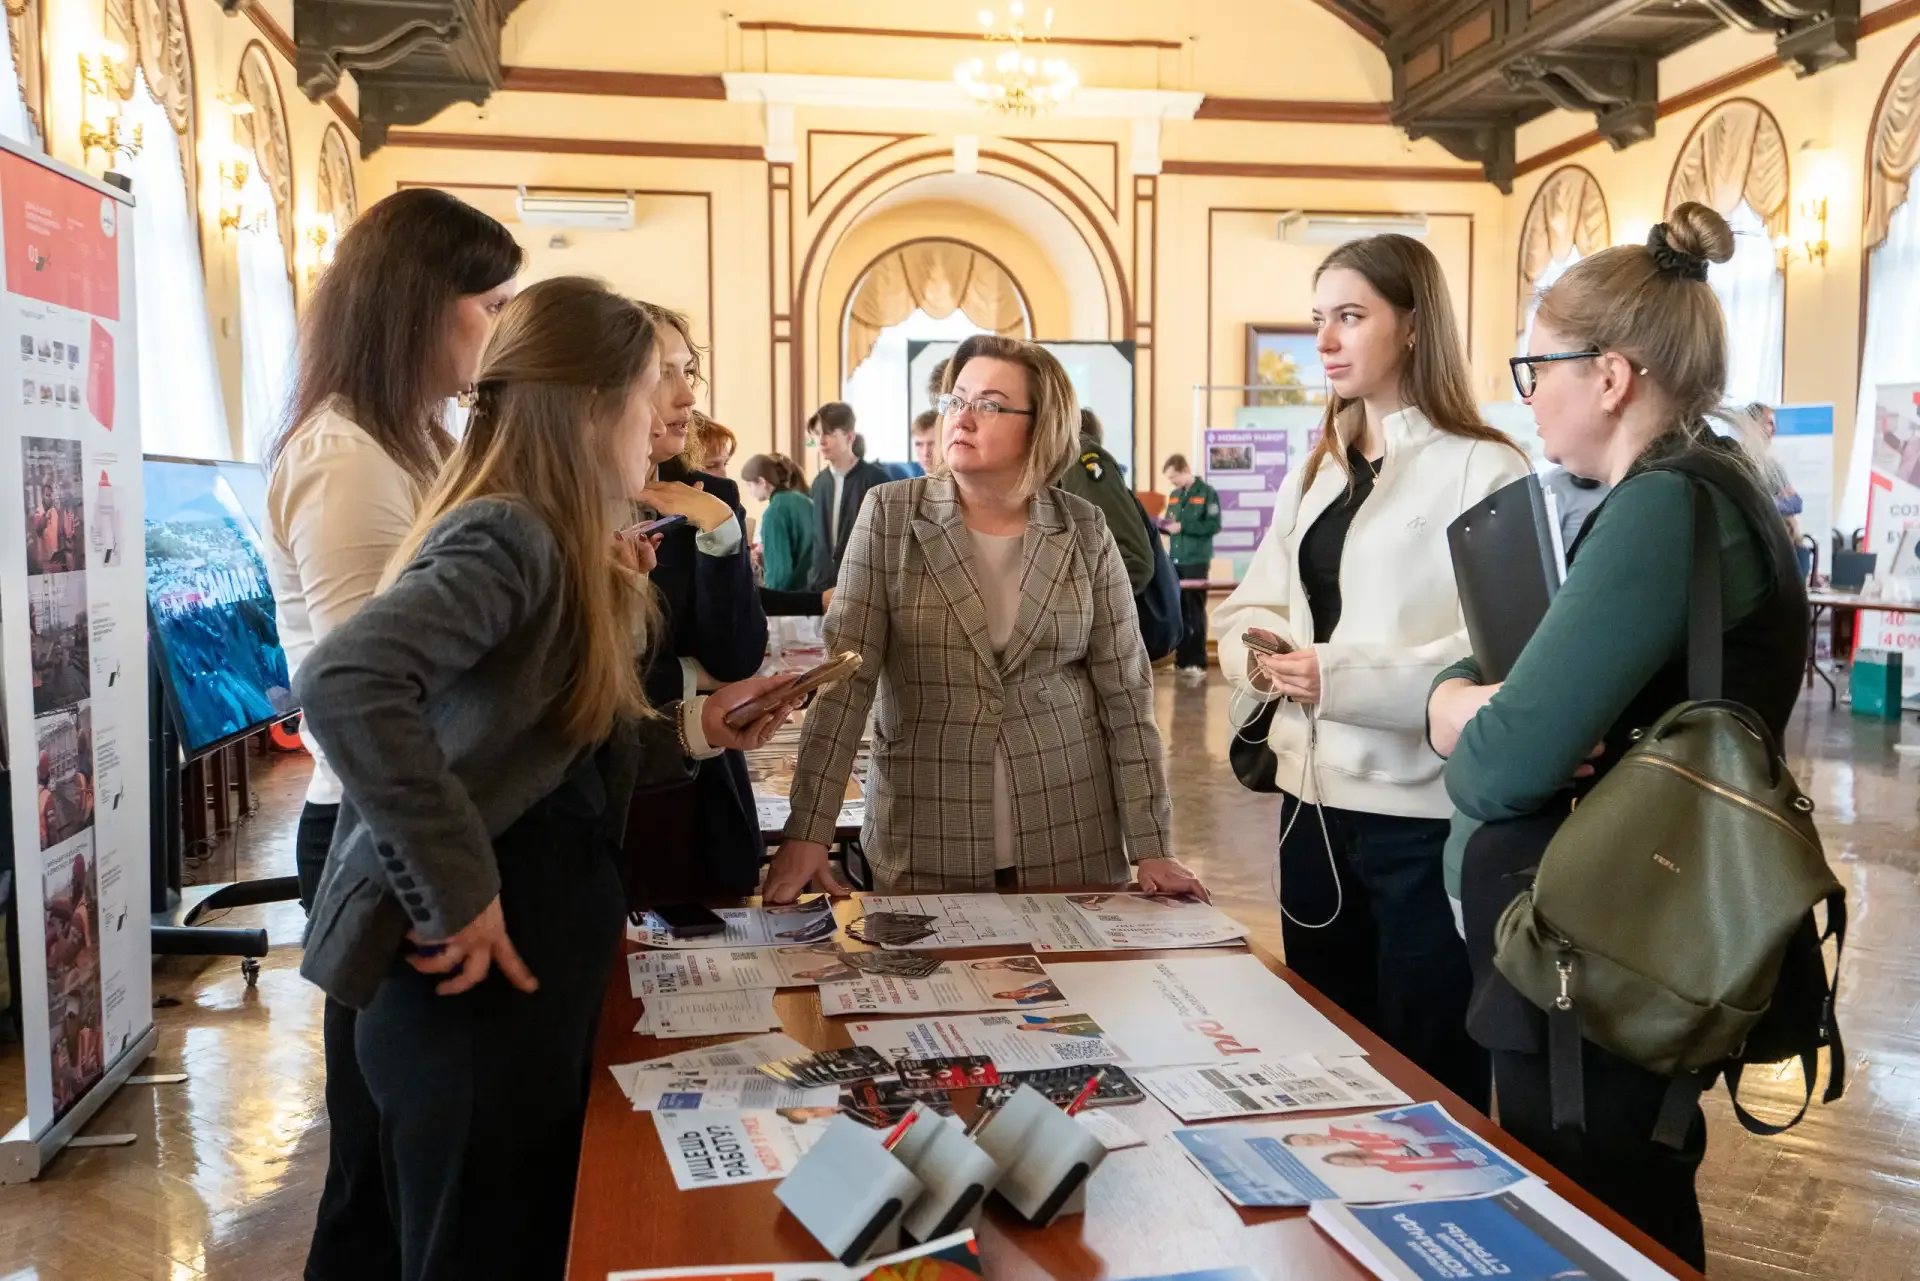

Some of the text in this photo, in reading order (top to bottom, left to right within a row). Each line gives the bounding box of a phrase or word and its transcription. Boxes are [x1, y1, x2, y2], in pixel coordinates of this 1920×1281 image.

[196, 566, 262, 608] САМАРА
[852, 988, 874, 1003] РЖД
[677, 1130, 719, 1182] ИЩЕШЬ
[706, 1125, 752, 1178] РАБОТУ?
[1392, 1212, 1474, 1278] КОМАНДА
[1440, 1222, 1512, 1274] СТРАНЫ
